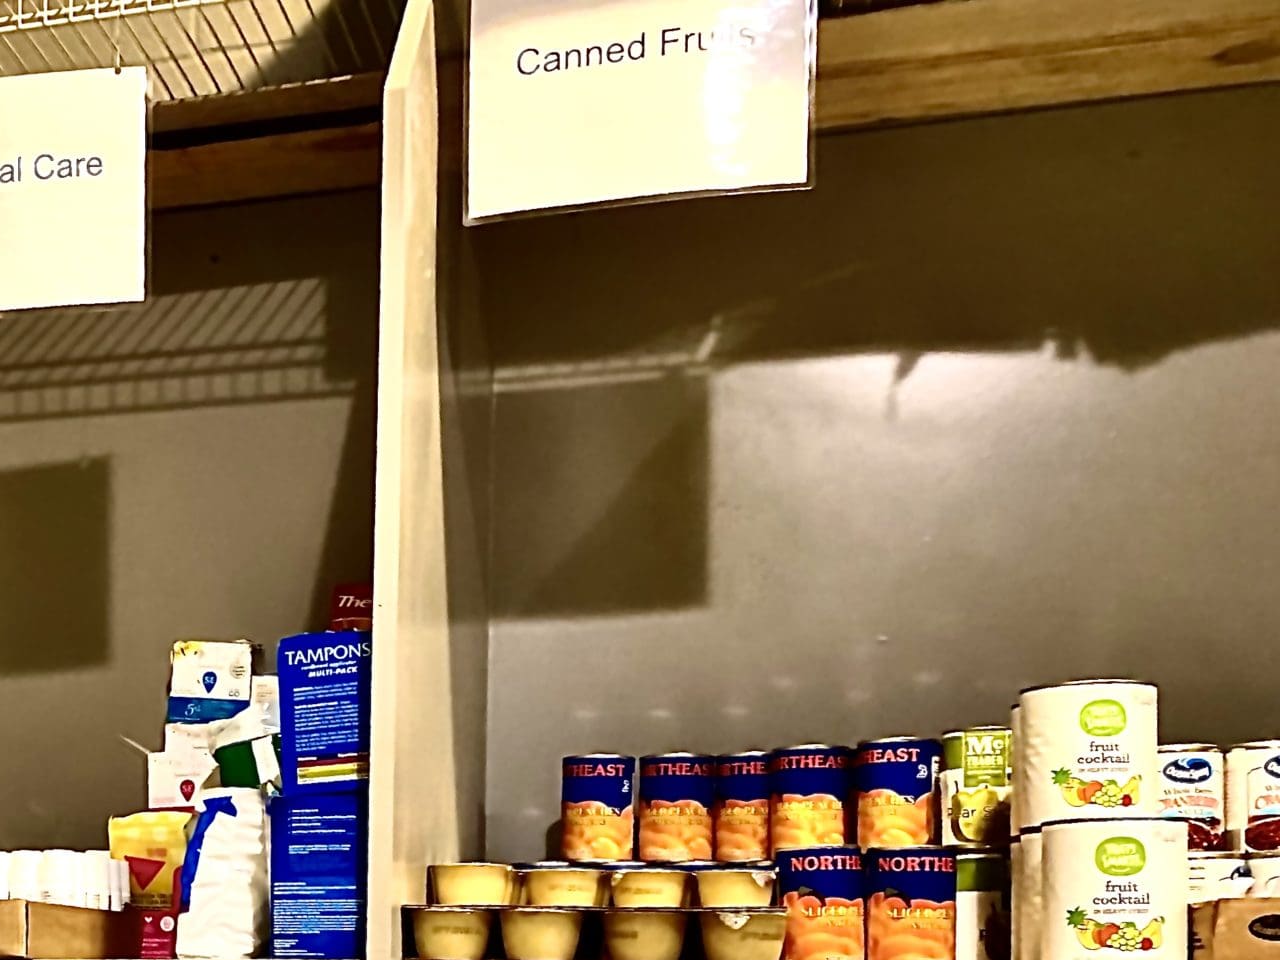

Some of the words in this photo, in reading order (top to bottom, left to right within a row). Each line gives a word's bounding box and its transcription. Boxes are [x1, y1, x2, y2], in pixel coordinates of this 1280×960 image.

[516, 31, 646, 76] Canned
[33, 153, 104, 181] Care
[337, 594, 371, 609] The
[284, 642, 372, 666] TAMPONS
[308, 666, 359, 678] MULTI-PACK
[1089, 740, 1120, 752] fruit
[1076, 752, 1131, 765] cocktail
[1105, 879, 1139, 893] fruit
[1092, 892, 1151, 906] cocktail
